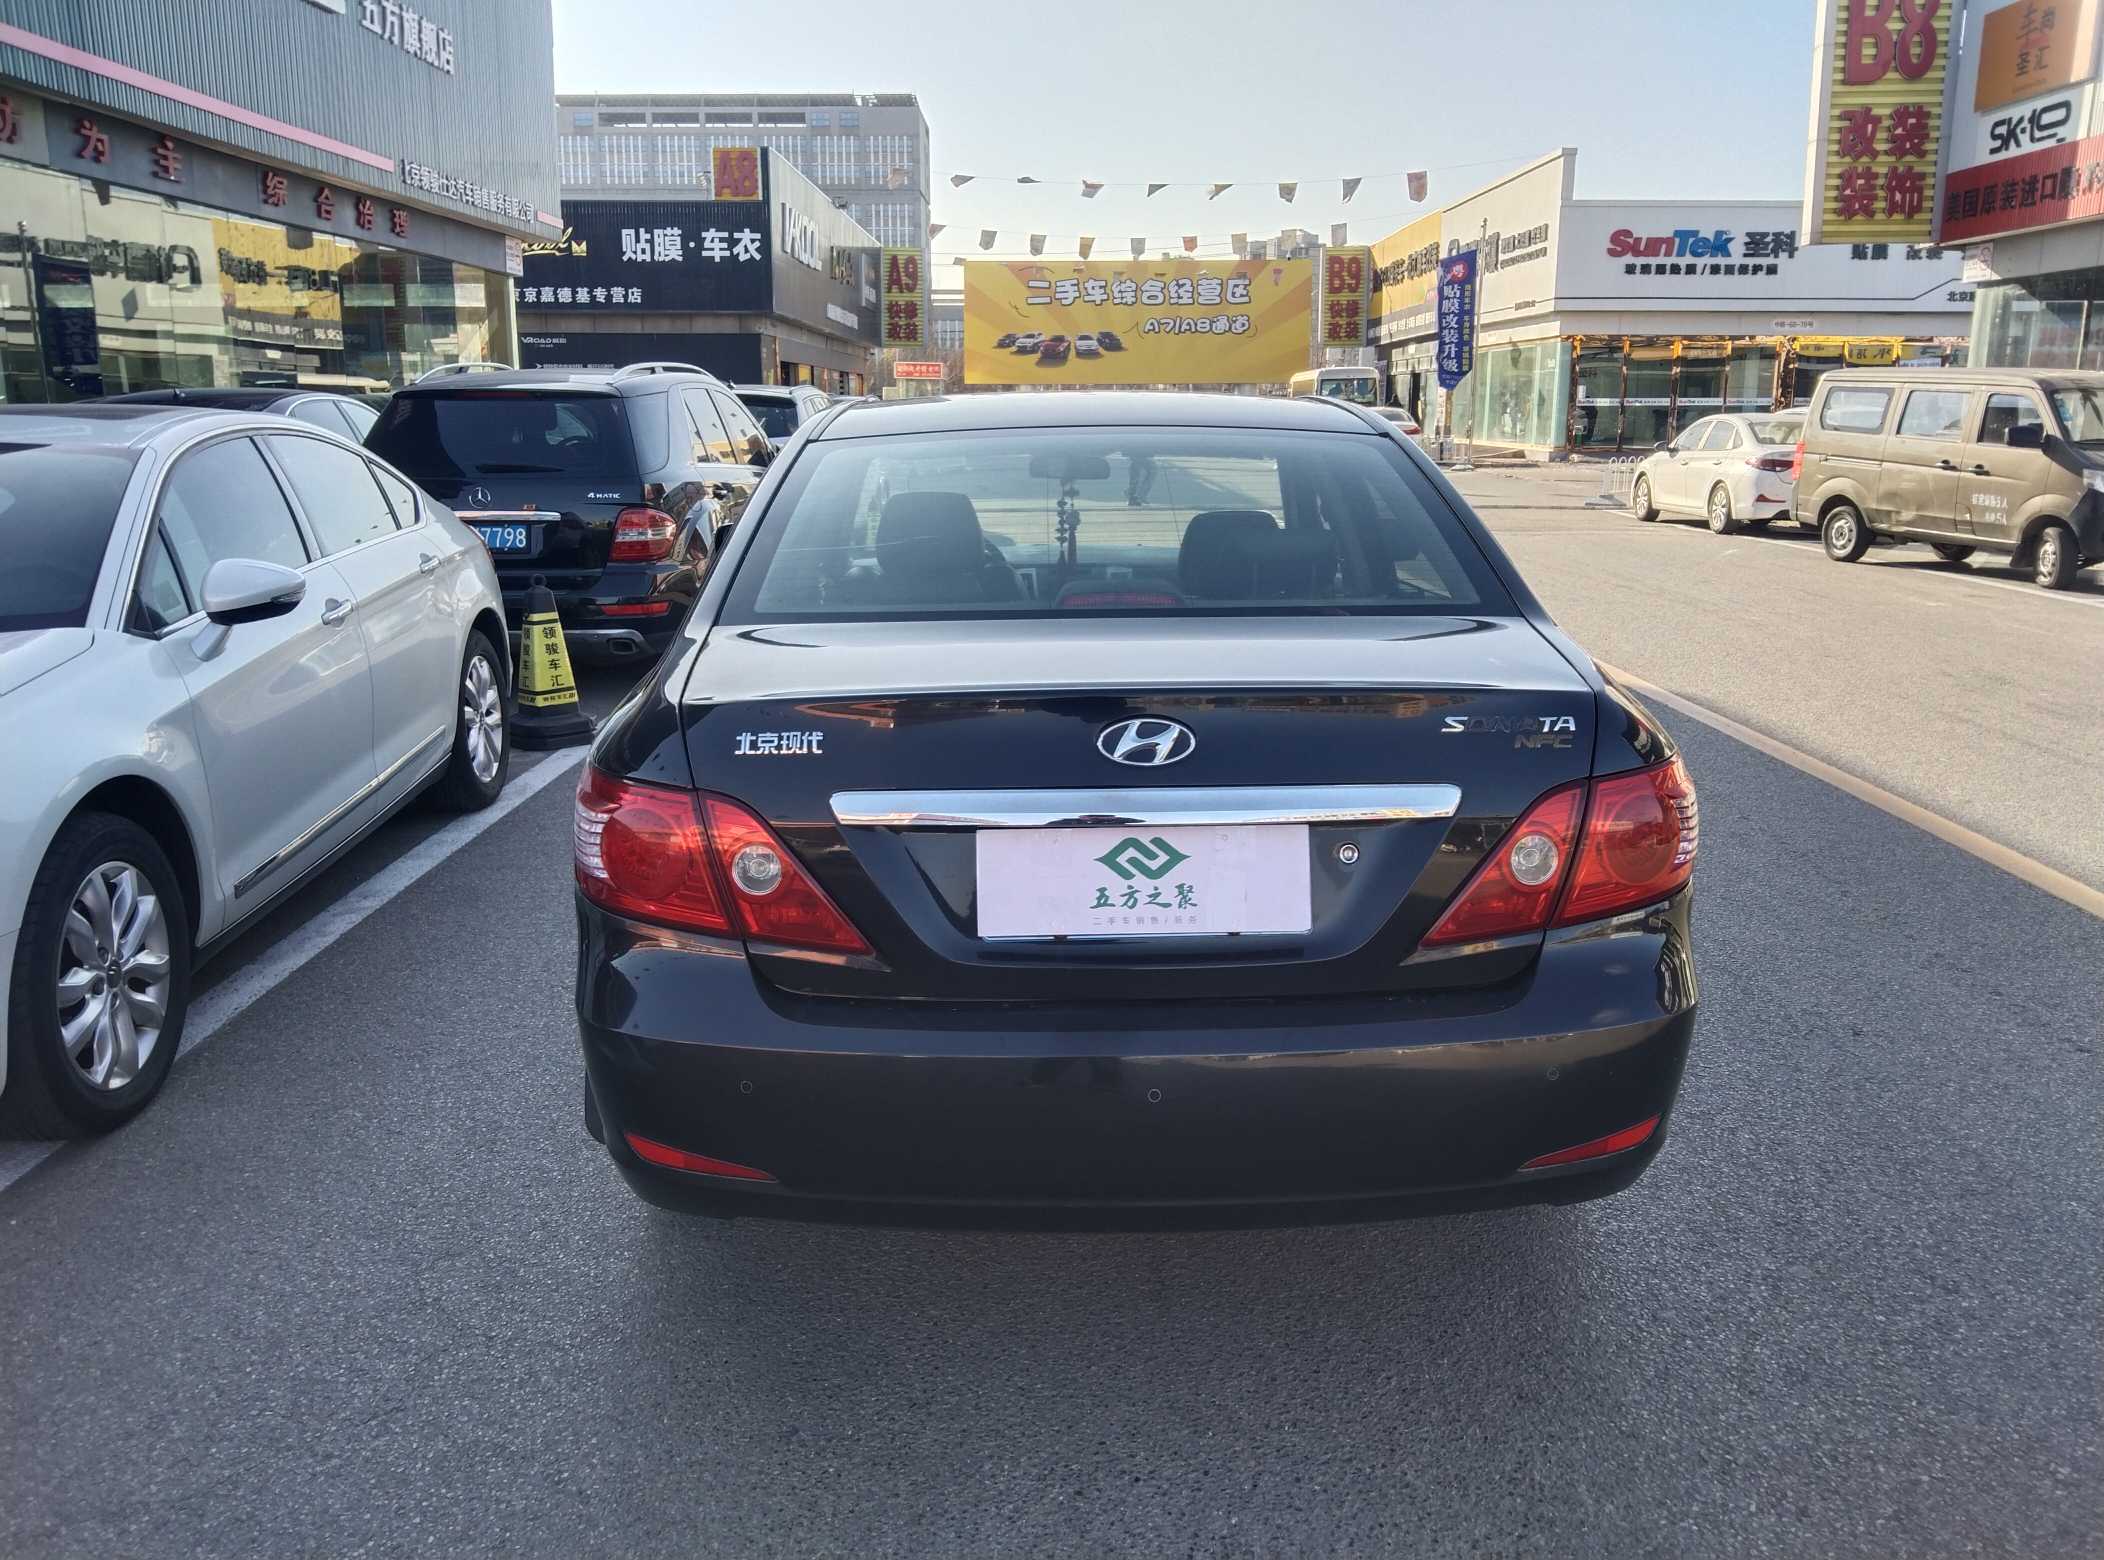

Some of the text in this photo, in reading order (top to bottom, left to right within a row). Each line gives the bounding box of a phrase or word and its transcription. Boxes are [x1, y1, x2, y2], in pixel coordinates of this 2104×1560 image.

[360, 0, 454, 76] 五方旗舰店
[1843, 0, 1940, 85] B8
[1839, 105, 1932, 161] 改装
[715, 151, 758, 197] A8
[1835, 166, 1929, 220] 装饰
[1945, 162, 2104, 224] 美国原装进口
[263, 170, 409, 239] 综合治理
[621, 227, 762, 263] 贴膜·车衣
[1606, 228, 1799, 259] SunTek 圣科
[888, 255, 919, 293] A9
[1026, 278, 1252, 306] 二手车综合经营区
[1328, 255, 1360, 294] B9
[1441, 284, 1462, 373] 贴膜改装升级
[476, 528, 528, 548] 7798
[542, 626, 566, 688] 领骏车汇
[735, 732, 824, 755] 北京现代
[1089, 883, 1198, 909] 五方之聚
